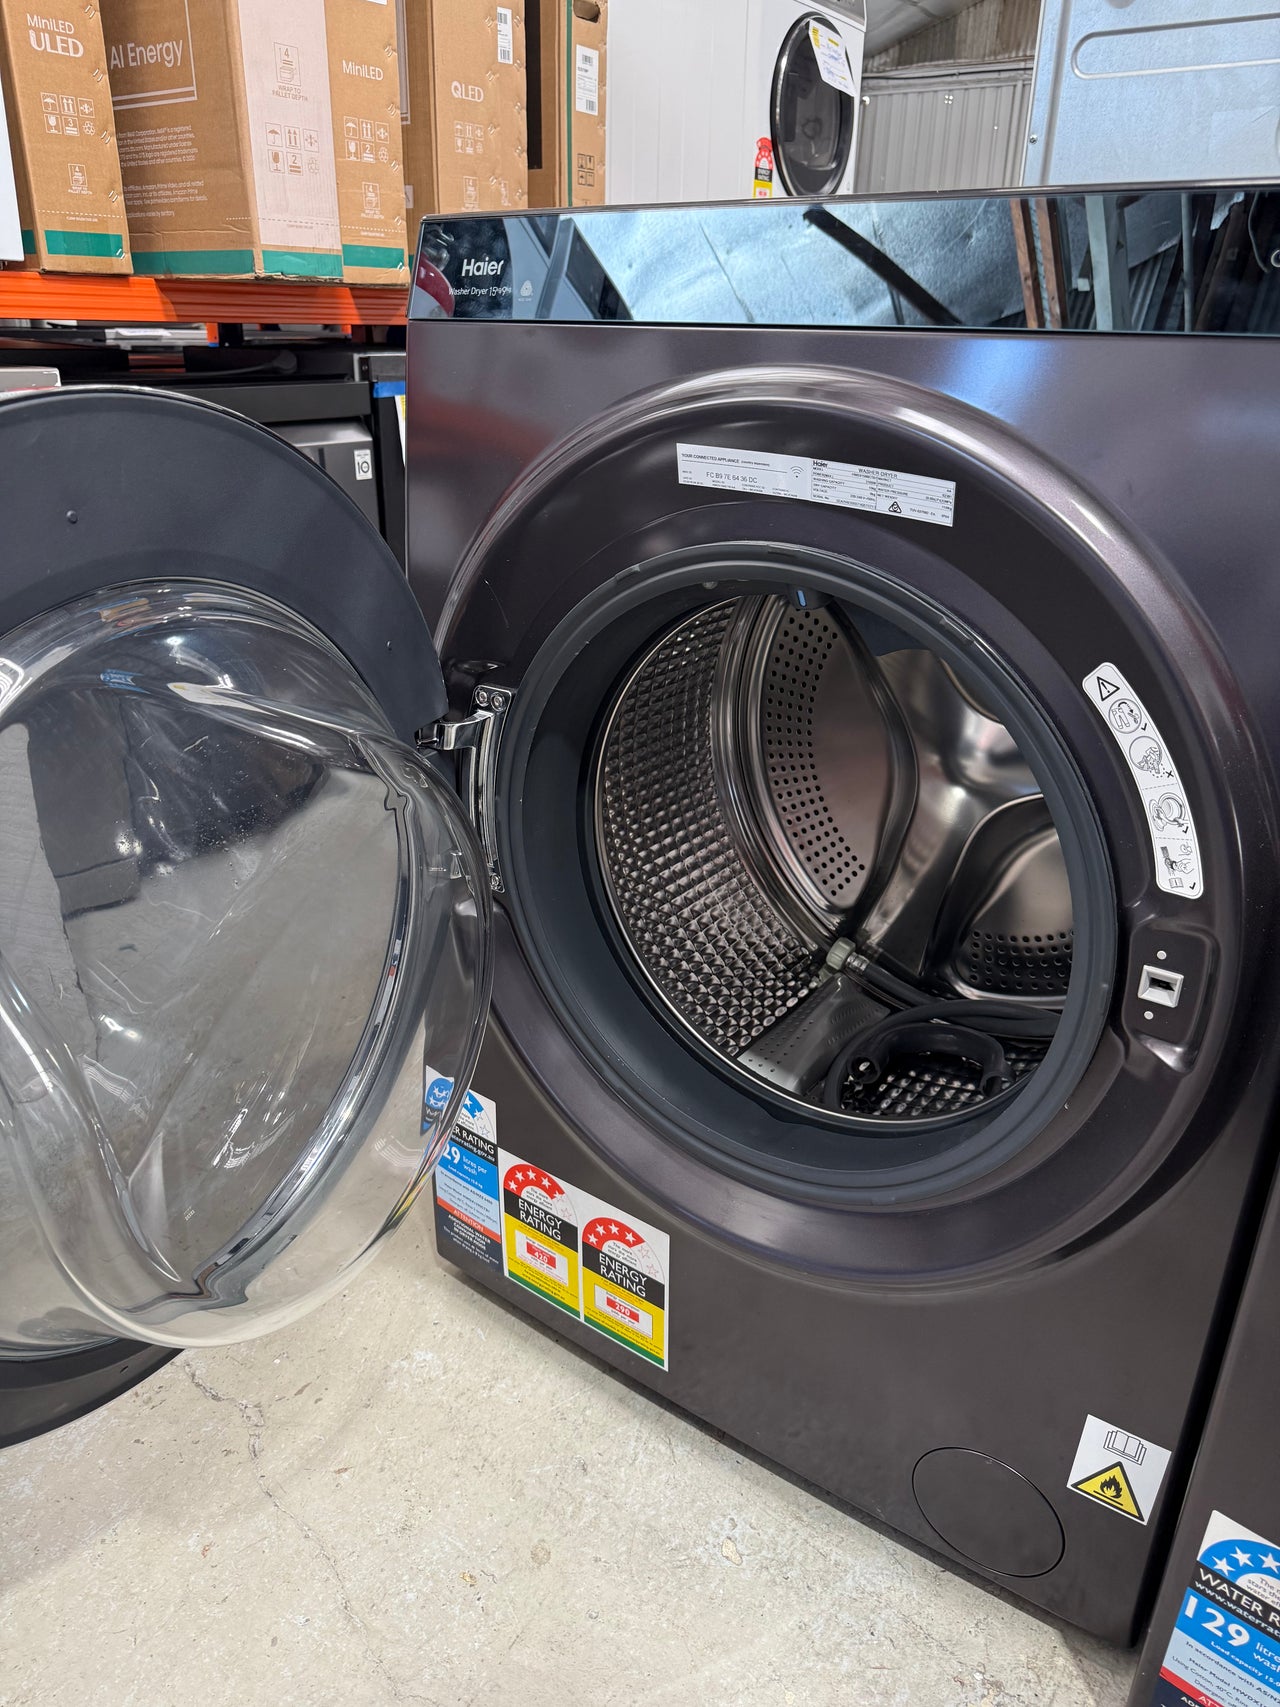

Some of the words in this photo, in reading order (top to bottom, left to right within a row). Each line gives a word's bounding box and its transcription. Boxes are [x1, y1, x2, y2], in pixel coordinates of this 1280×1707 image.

[26, 13, 74, 34] MiniLED
[29, 30, 84, 58] ULED
[127, 40, 183, 68] Energy
[342, 60, 384, 80] MiniLED
[451, 80, 484, 102] QLED
[462, 256, 504, 276] Haier
[448, 286, 470, 296] Washer
[470, 286, 488, 296] Dryer
[357, 460, 370, 474] 10
[812, 460, 827, 468] Haier
[442, 1142, 460, 1164] 29
[462, 1131, 494, 1155] RATING
[453, 1208, 483, 1232] ATTENTION
[518, 1198, 562, 1230] ENERGY
[520, 1210, 561, 1241] RATING
[534, 1250, 547, 1264] 420
[599, 1252, 647, 1288] ENERGY
[600, 1264, 645, 1298] RATING
[615, 1302, 630, 1317] 290
[1200, 1566, 1263, 1618] WATER
[1246, 1584, 1270, 1600] water
[1248, 1579, 1267, 1592] stars
[1260, 1576, 1274, 1590] The
[1184, 1594, 1250, 1647] 129
[1256, 1642, 1280, 1664] litre
[1194, 1648, 1236, 1676] accordance
[1238, 1675, 1254, 1688] with
[1210, 1640, 1230, 1656] Load
[1230, 1654, 1263, 1677] capacity
[1210, 1670, 1230, 1687] Model
